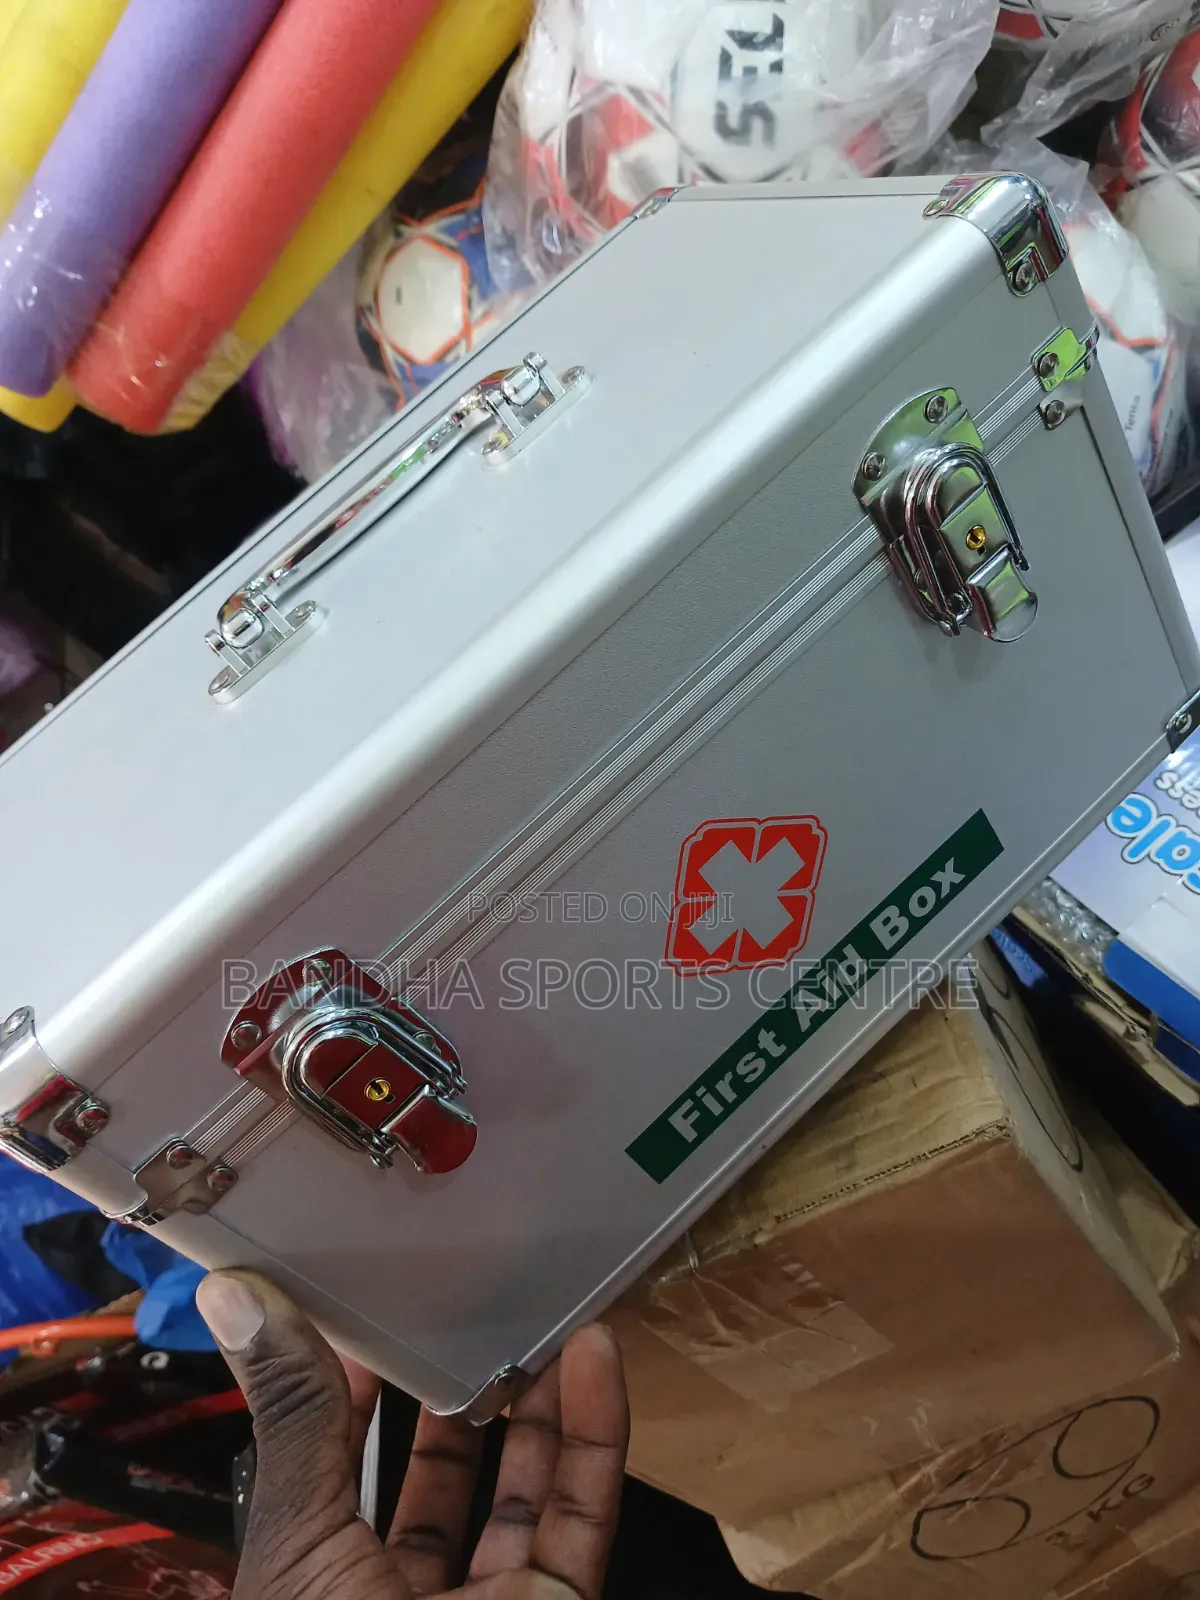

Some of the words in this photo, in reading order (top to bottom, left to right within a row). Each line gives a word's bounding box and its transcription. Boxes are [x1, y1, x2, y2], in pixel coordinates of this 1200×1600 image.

[714, 0, 785, 150] SEL
[1153, 770, 1200, 819] ess
[668, 1027, 788, 1143] First
[790, 943, 869, 1032] Aid
[869, 856, 966, 951] Box
